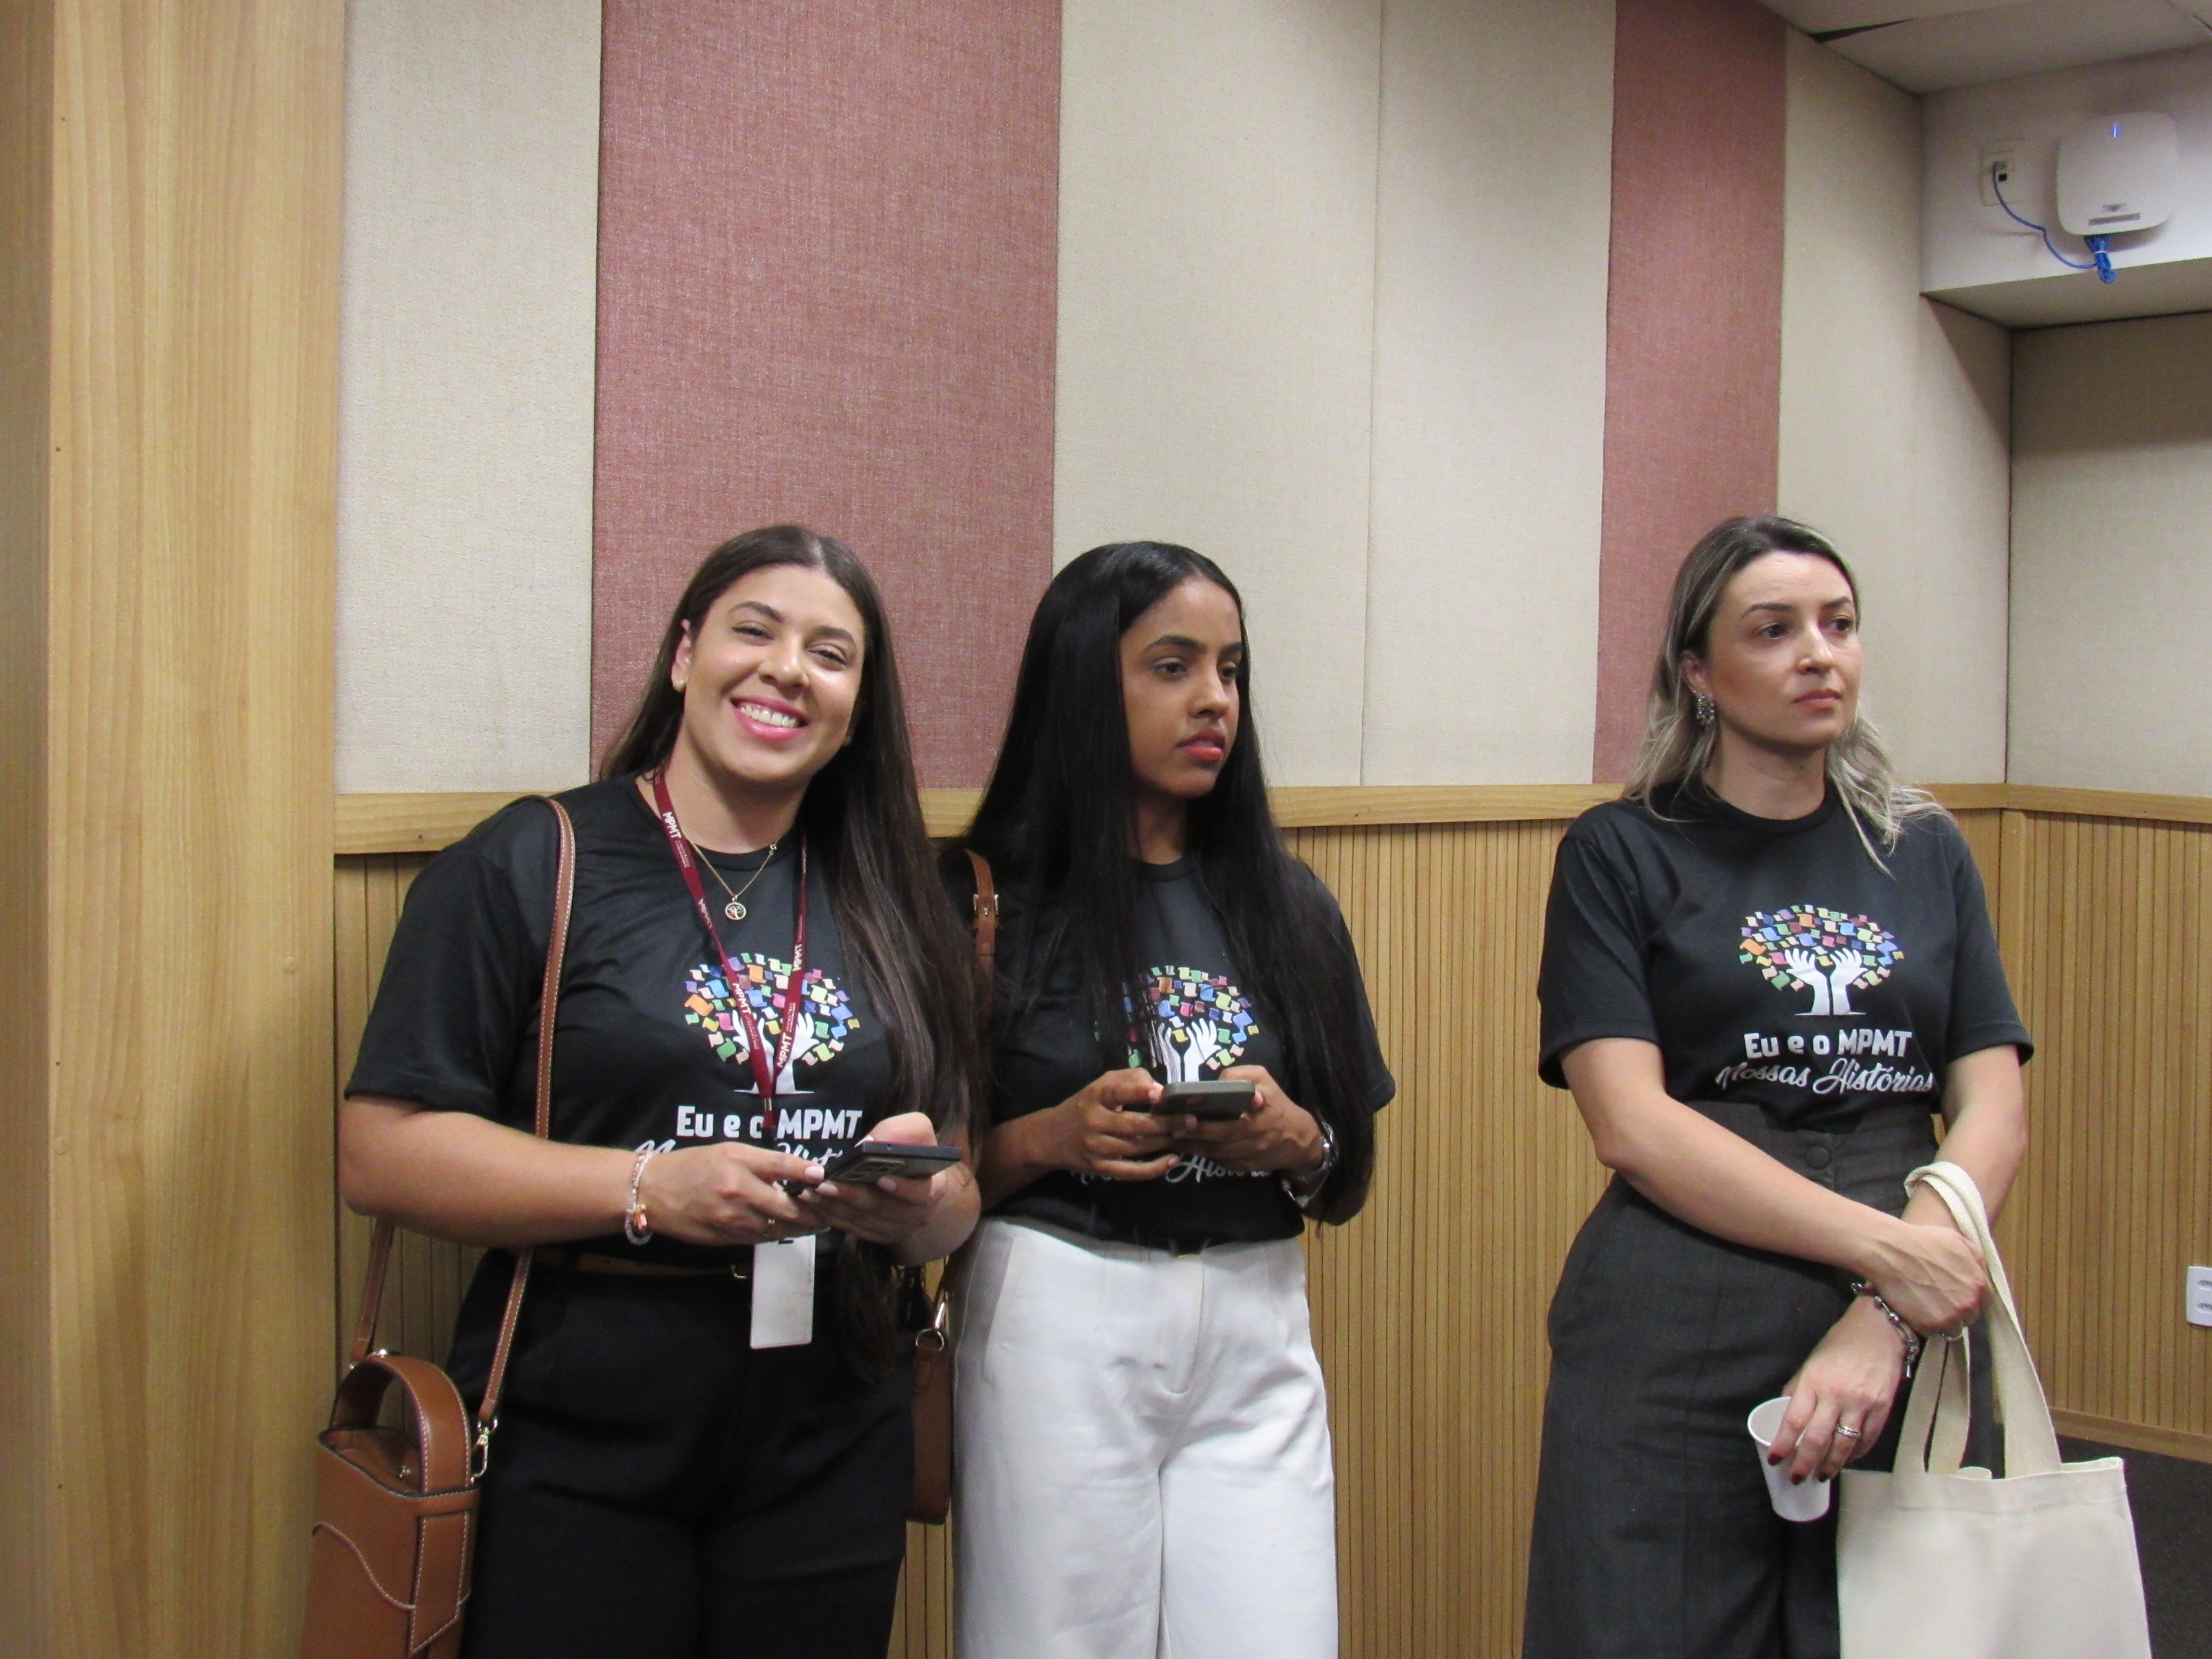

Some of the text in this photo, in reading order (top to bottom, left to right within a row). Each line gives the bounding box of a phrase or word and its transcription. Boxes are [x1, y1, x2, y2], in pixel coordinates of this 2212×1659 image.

[663, 811, 682, 839] MPMT
[792, 944, 802, 971] MPMT
[733, 983, 752, 1015] MPMT
[777, 1032, 792, 1067] MPMT
[1744, 1029, 1912, 1059] Eu e o MPMT
[1715, 1058, 1936, 1094] Nossas Histórias
[677, 1105, 714, 1137] Eu
[724, 1115, 741, 1138] e
[777, 1109, 863, 1140] MPMT
